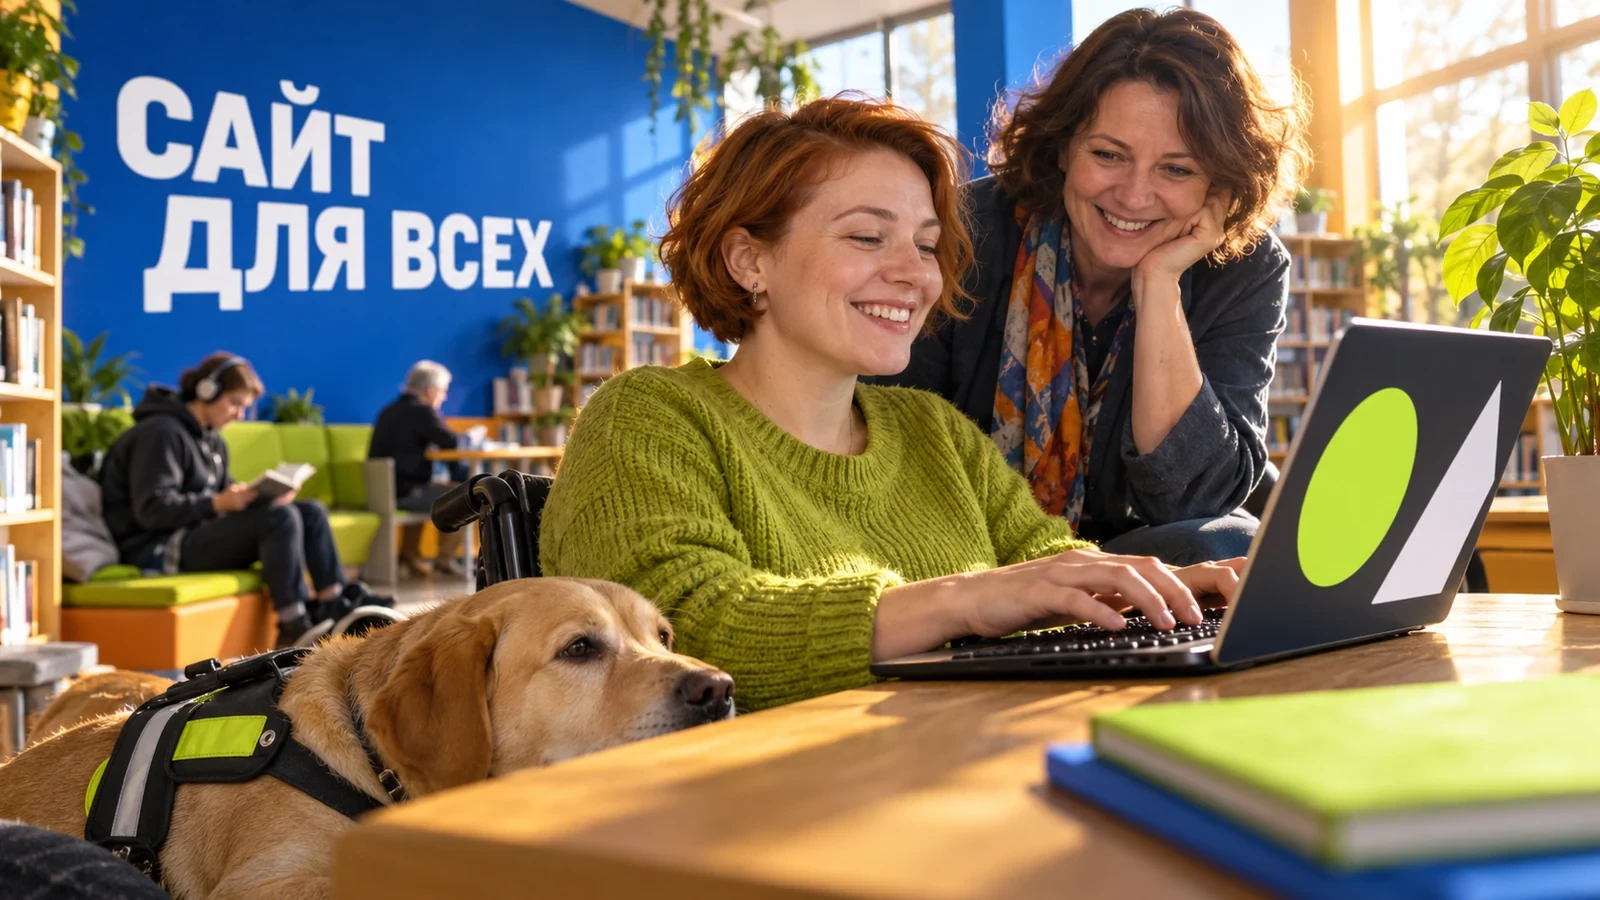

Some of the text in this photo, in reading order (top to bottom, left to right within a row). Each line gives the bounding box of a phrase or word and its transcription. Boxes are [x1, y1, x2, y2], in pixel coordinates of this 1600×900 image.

[117, 76, 385, 196] САЙТ
[143, 195, 553, 312] ДЛЯ ВСЕХ
